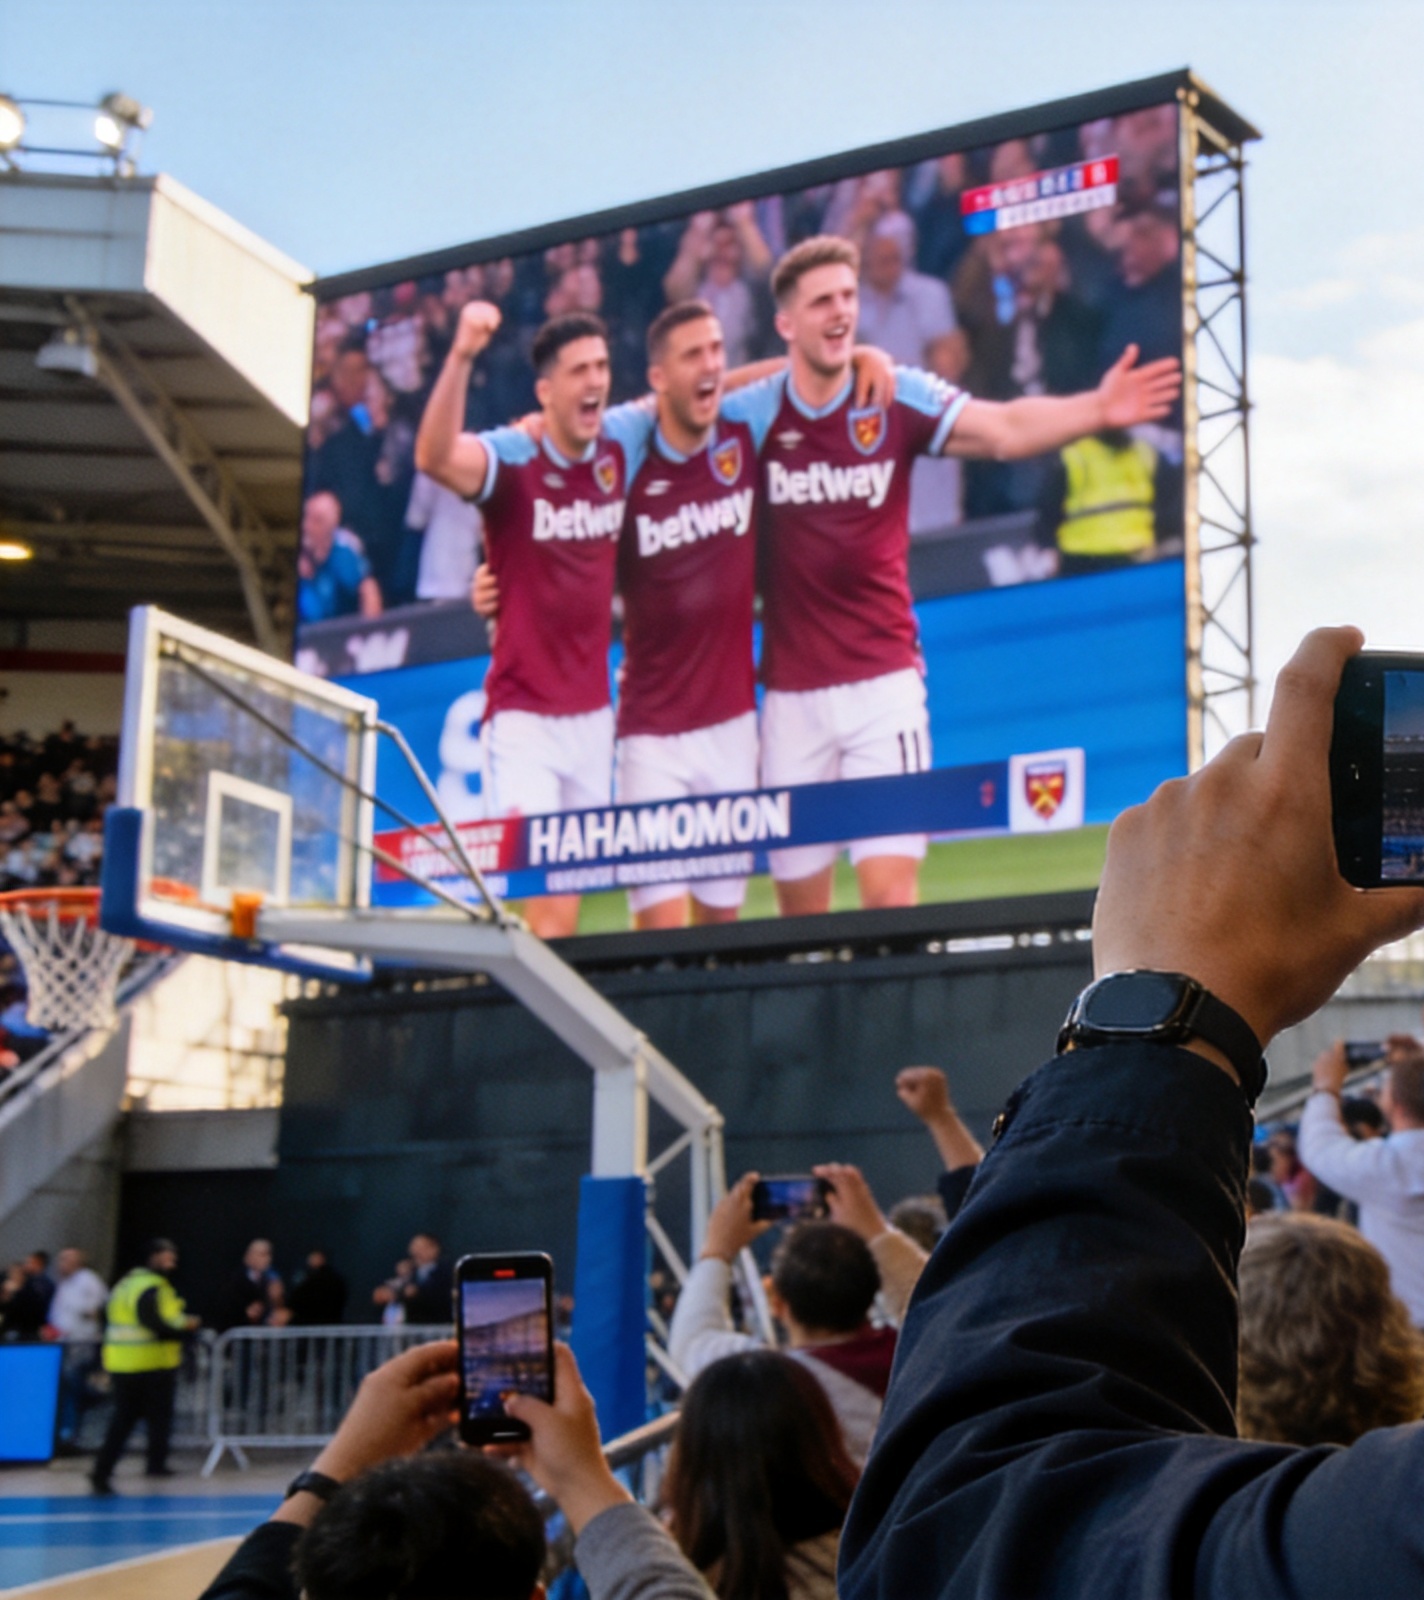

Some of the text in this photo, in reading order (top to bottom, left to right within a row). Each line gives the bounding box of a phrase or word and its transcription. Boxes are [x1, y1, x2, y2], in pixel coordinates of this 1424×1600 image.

[767, 459, 895, 509] betway
[636, 488, 754, 557] betway
[529, 791, 791, 867] HAHAMOMON
